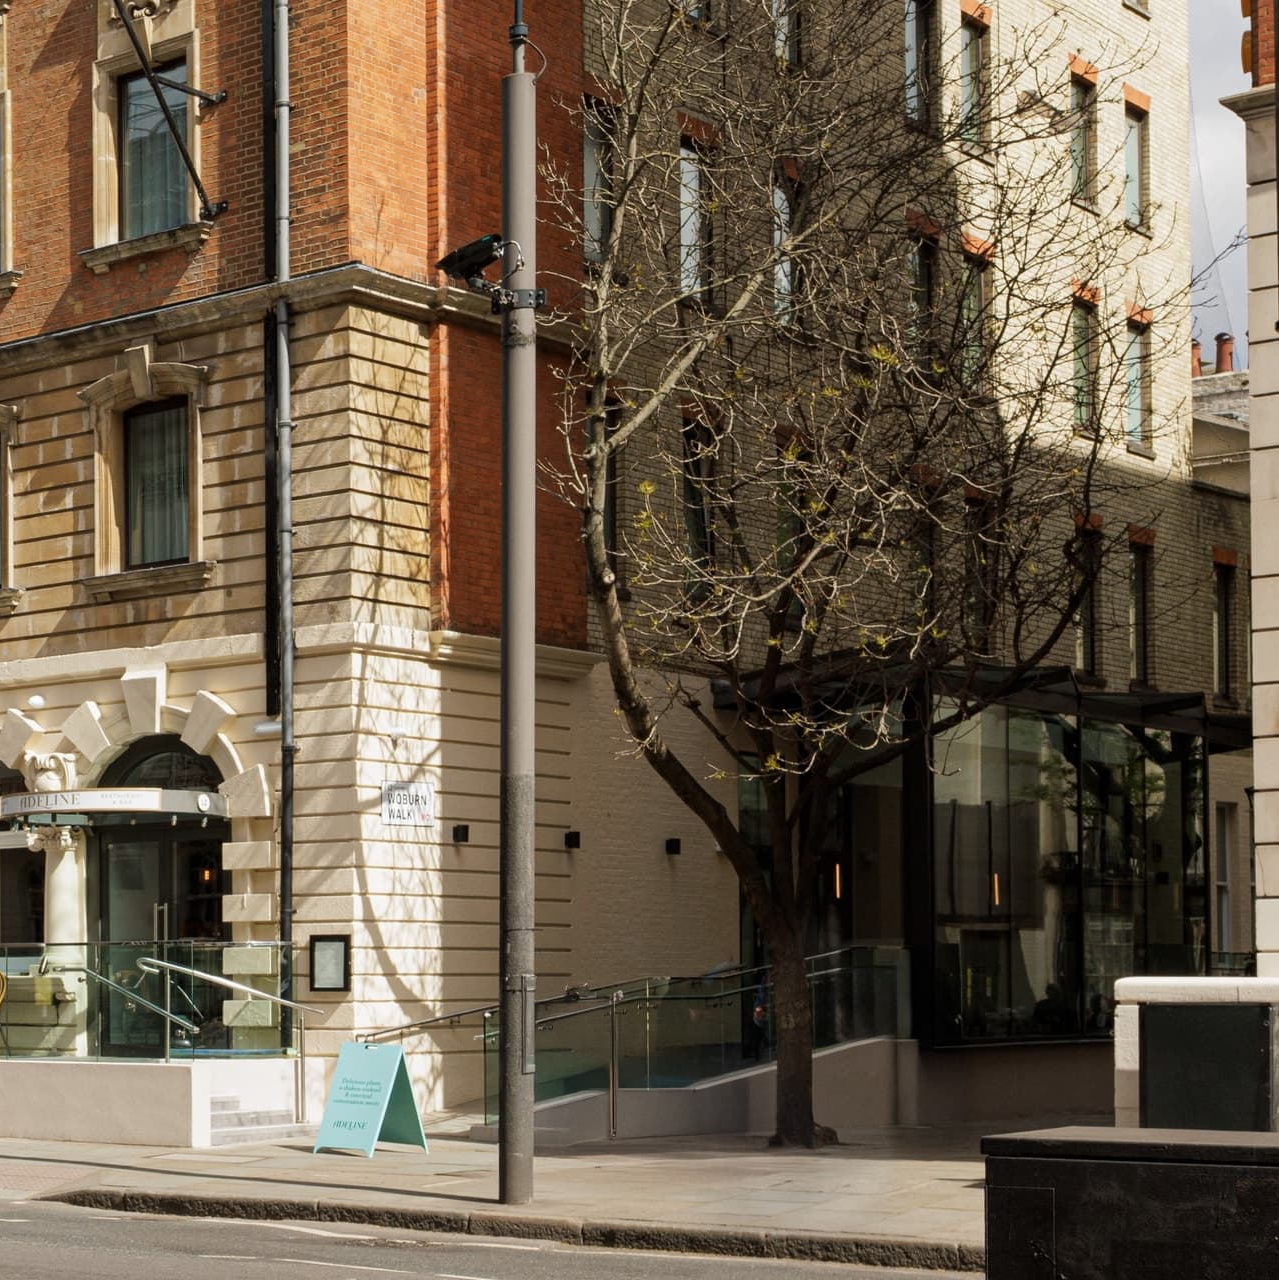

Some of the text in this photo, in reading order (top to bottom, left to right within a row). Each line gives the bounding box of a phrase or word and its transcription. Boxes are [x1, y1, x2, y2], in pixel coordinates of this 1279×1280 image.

[21, 793, 81, 809] ADELINE
[387, 793, 427, 807] WOBURN
[388, 808, 413, 820] WALK
